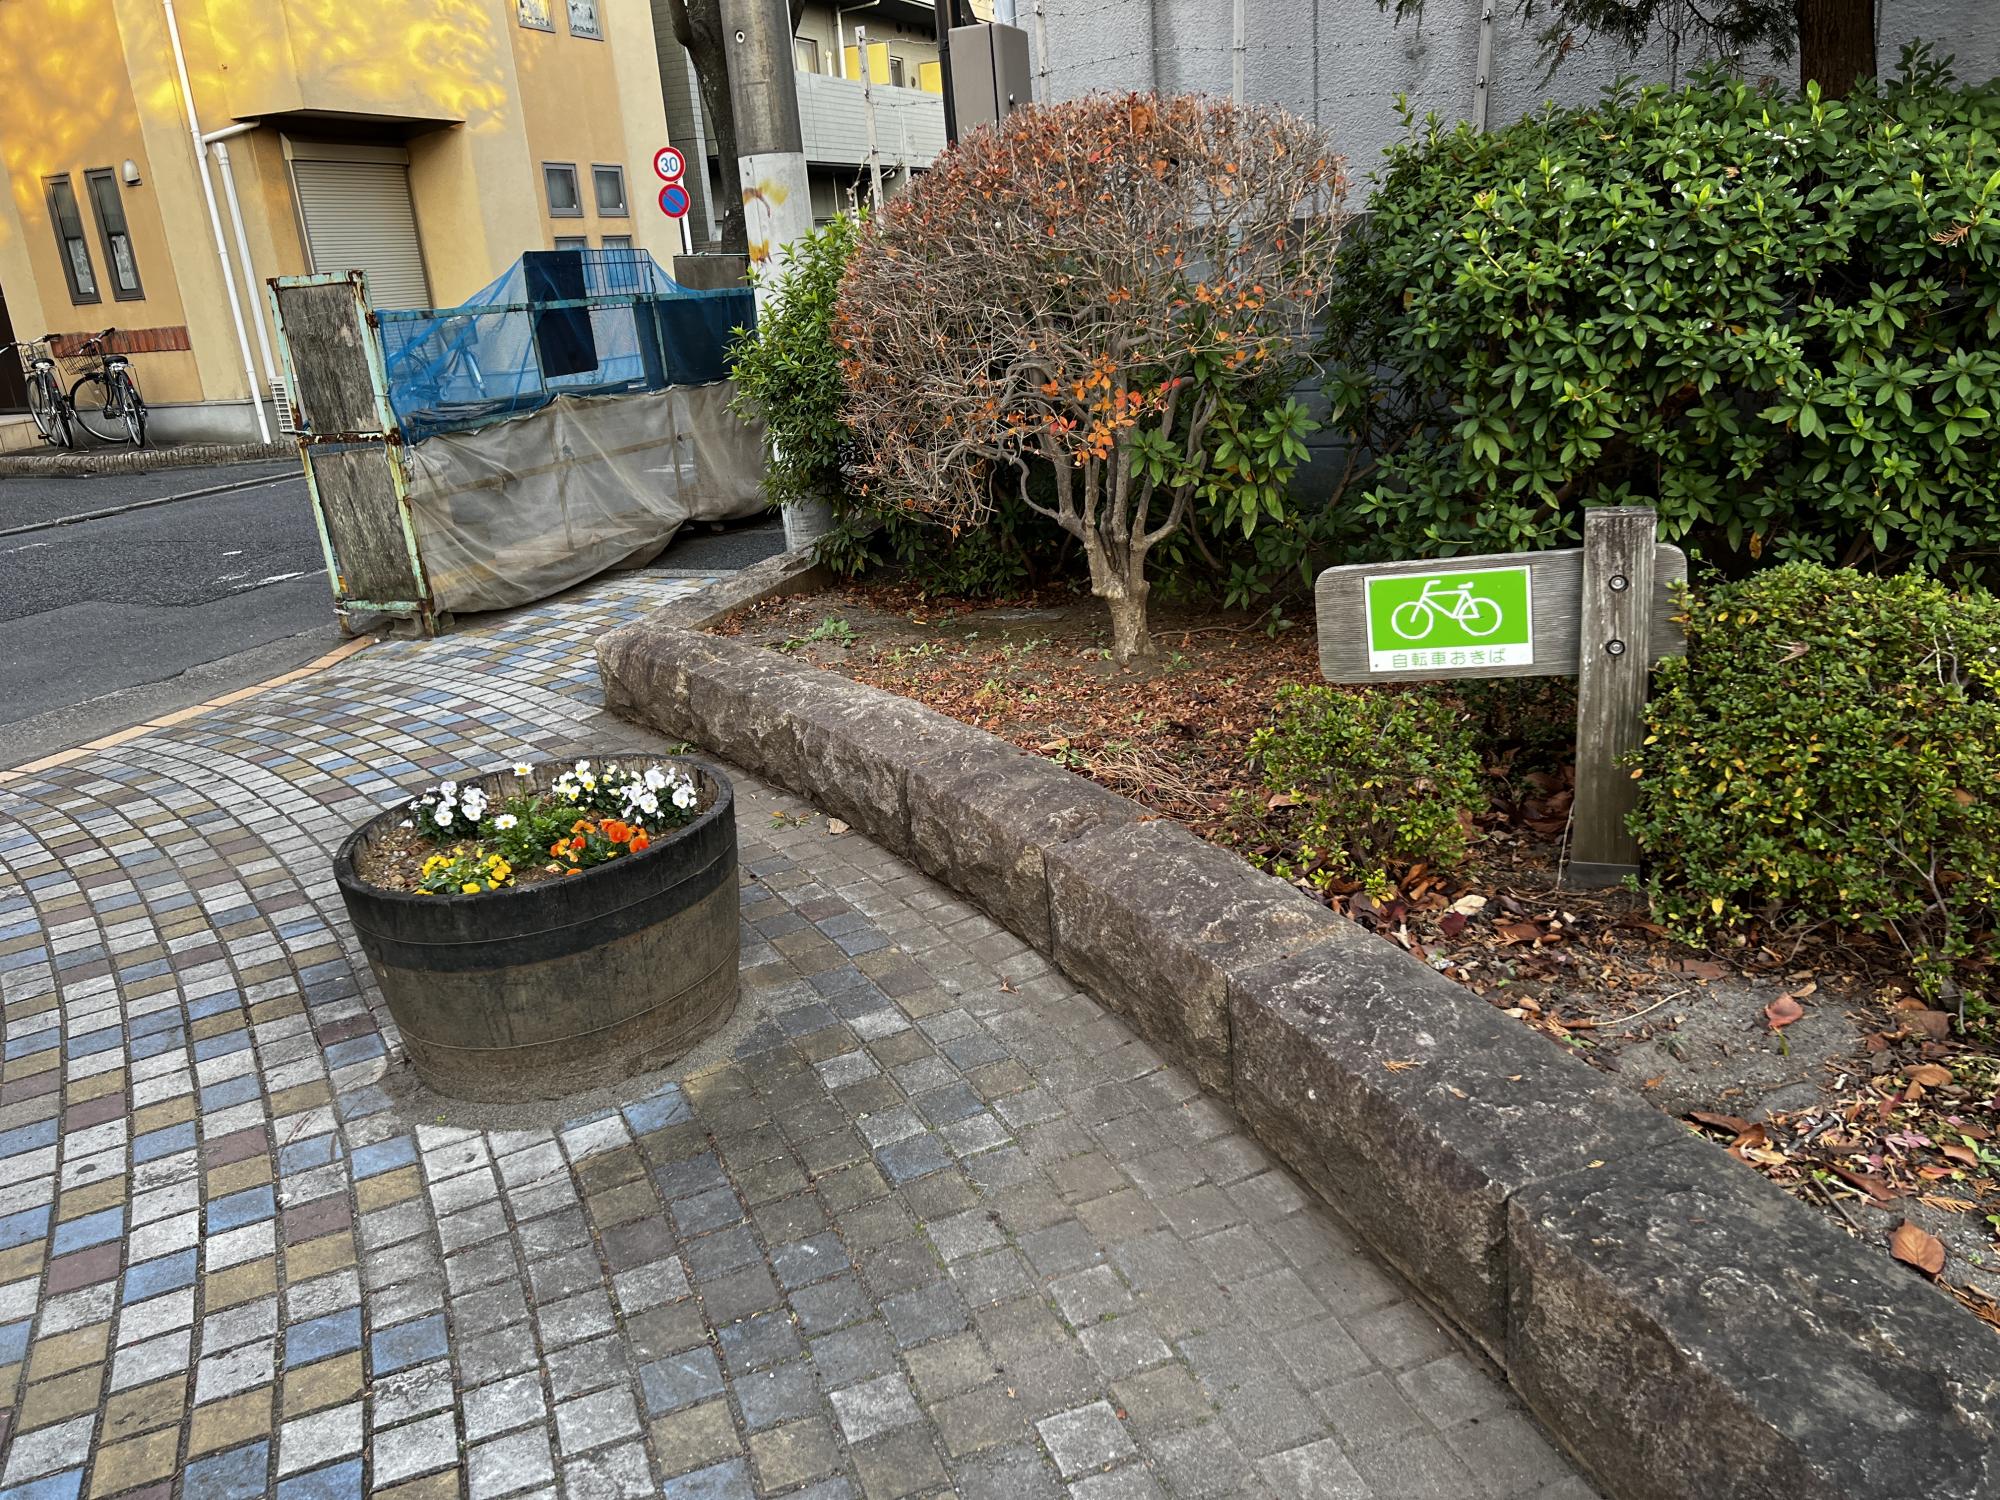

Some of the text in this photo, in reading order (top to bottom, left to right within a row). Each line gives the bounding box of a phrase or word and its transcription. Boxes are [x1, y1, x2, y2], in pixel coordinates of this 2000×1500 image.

[660, 157, 679, 173] 30
[1392, 648, 1507, 668] 自転車おきば
